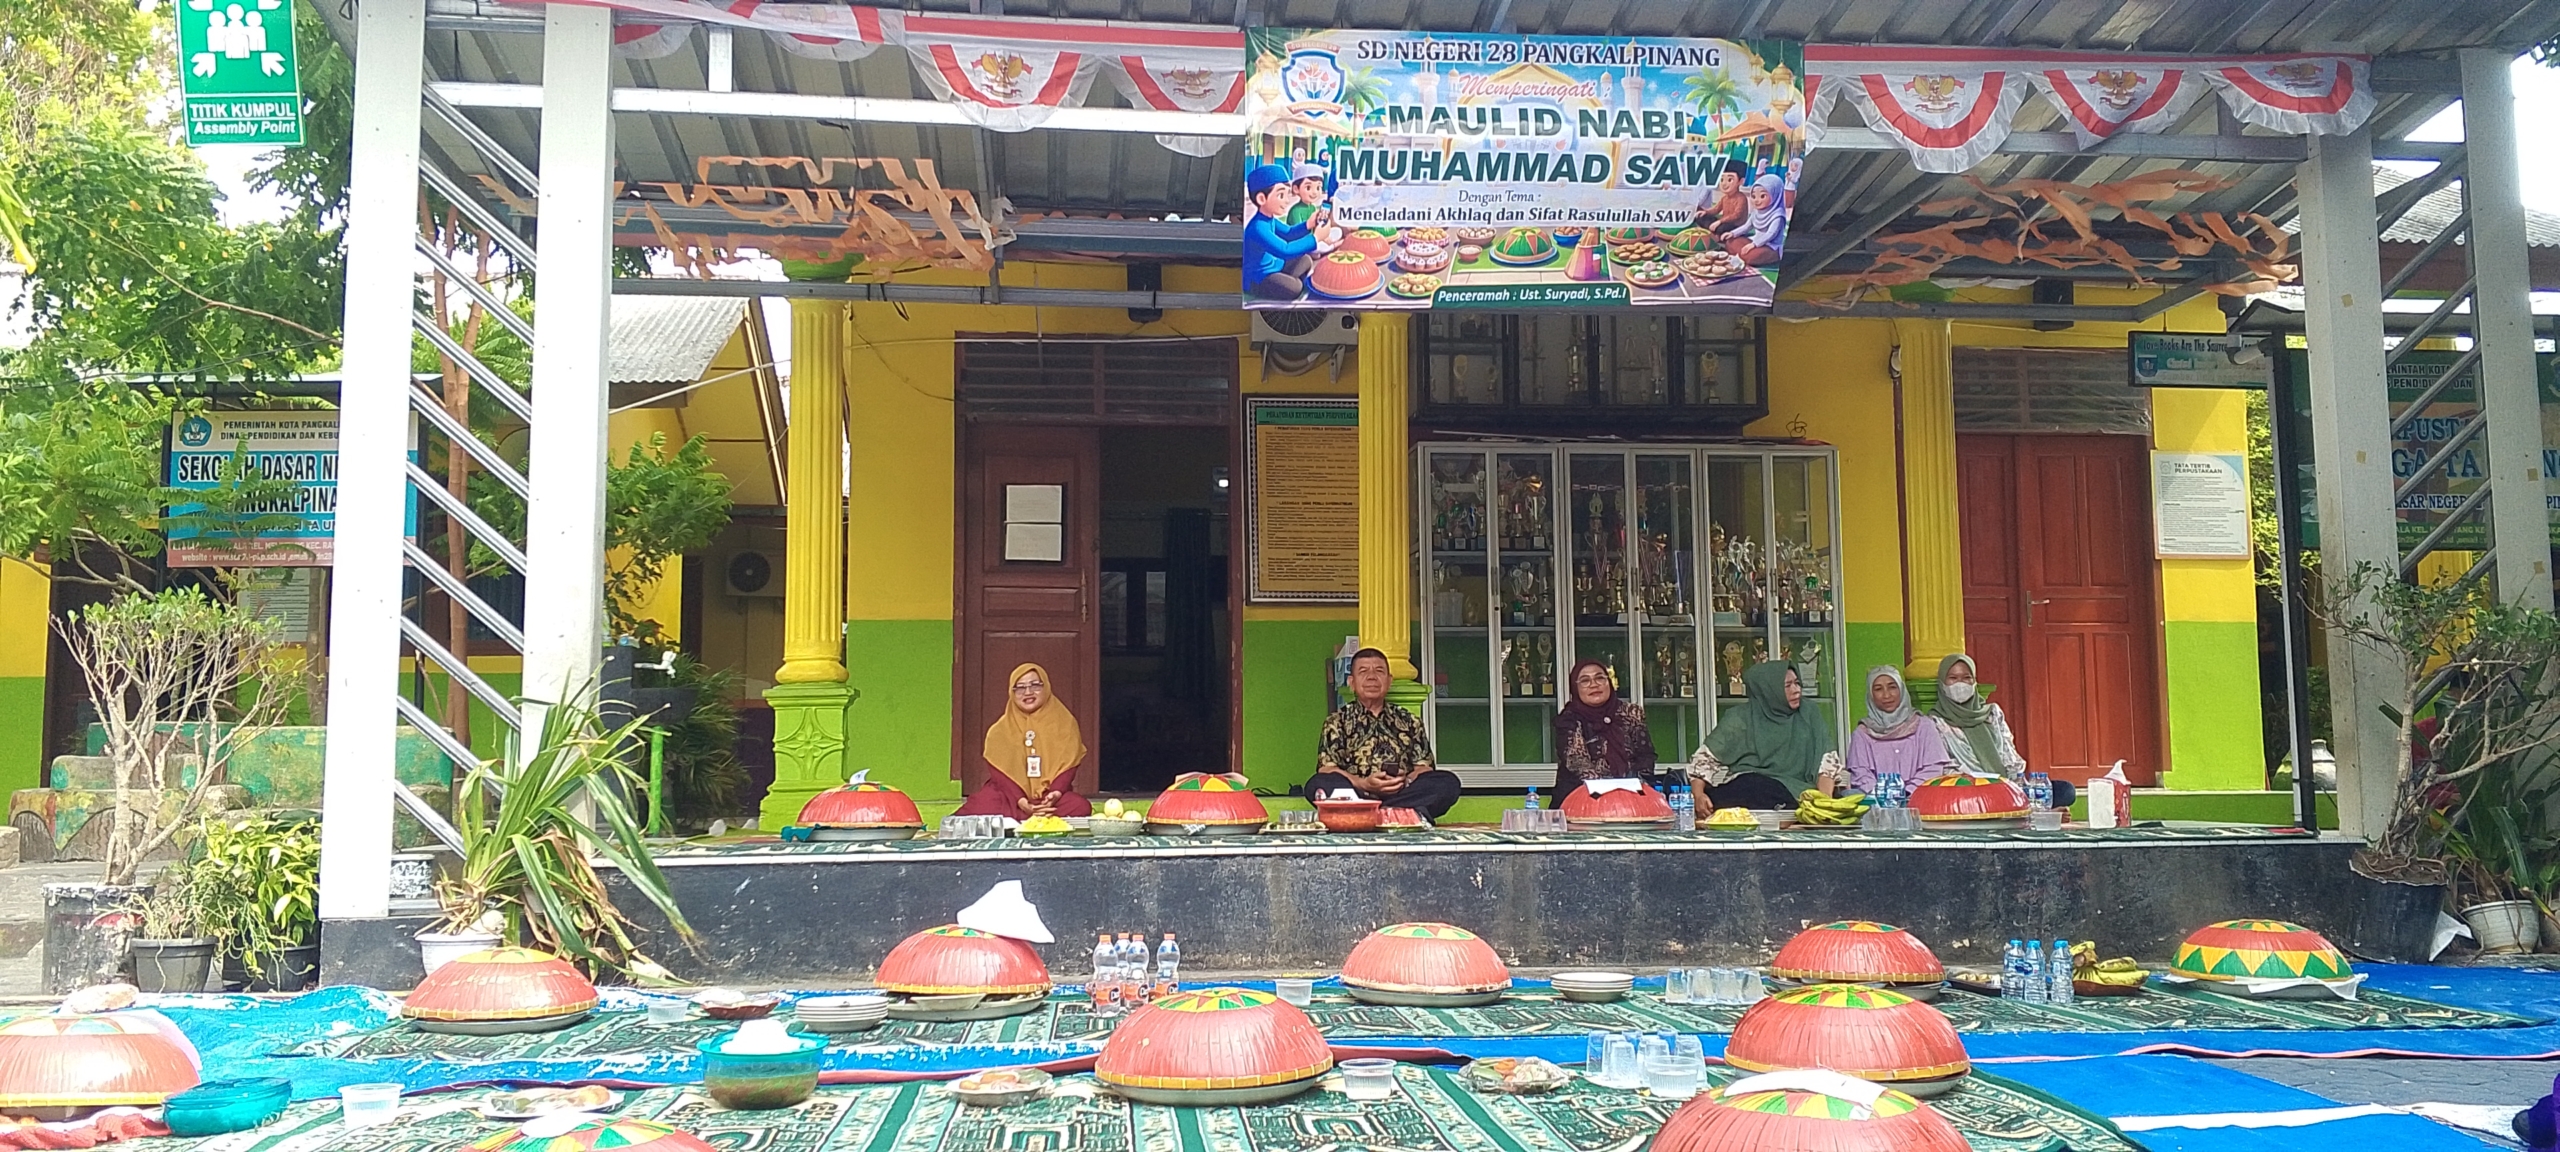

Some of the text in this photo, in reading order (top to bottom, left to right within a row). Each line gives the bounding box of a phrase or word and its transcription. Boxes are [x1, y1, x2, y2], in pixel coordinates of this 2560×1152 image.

[1358, 41, 1720, 67] SD NEGERI 28 PANGKALPINANG
[1458, 75, 1596, 101] Memperingati
[190, 102, 296, 118] TITIK KUMPUL
[194, 121, 296, 136] Assembly Point
[1388, 105, 1685, 140] MAULID NABI
[1338, 150, 1726, 187] MUHAMMAD SAW
[1458, 190, 1502, 206] Dengan
[1505, 190, 1534, 202] Tema
[1338, 207, 1691, 224] Meneladani Akhlaq dan Sifat Rasulullah SAW
[1438, 289, 1510, 303] Penceramah
[1519, 289, 1542, 301] Ust.
[1544, 287, 1591, 302] Suryadi,
[1593, 287, 1627, 299] S.Pd.I
[2181, 339, 2192, 350] Are
[2194, 339, 2206, 351] The
[223, 421, 276, 429] PEMERINTAH
[278, 421, 300, 429] KOTA
[247, 431, 297, 440] PENDIDIKAN
[299, 431, 315, 440] DAN
[262, 455, 317, 481] DASAR
[182, 552, 207, 561] website
